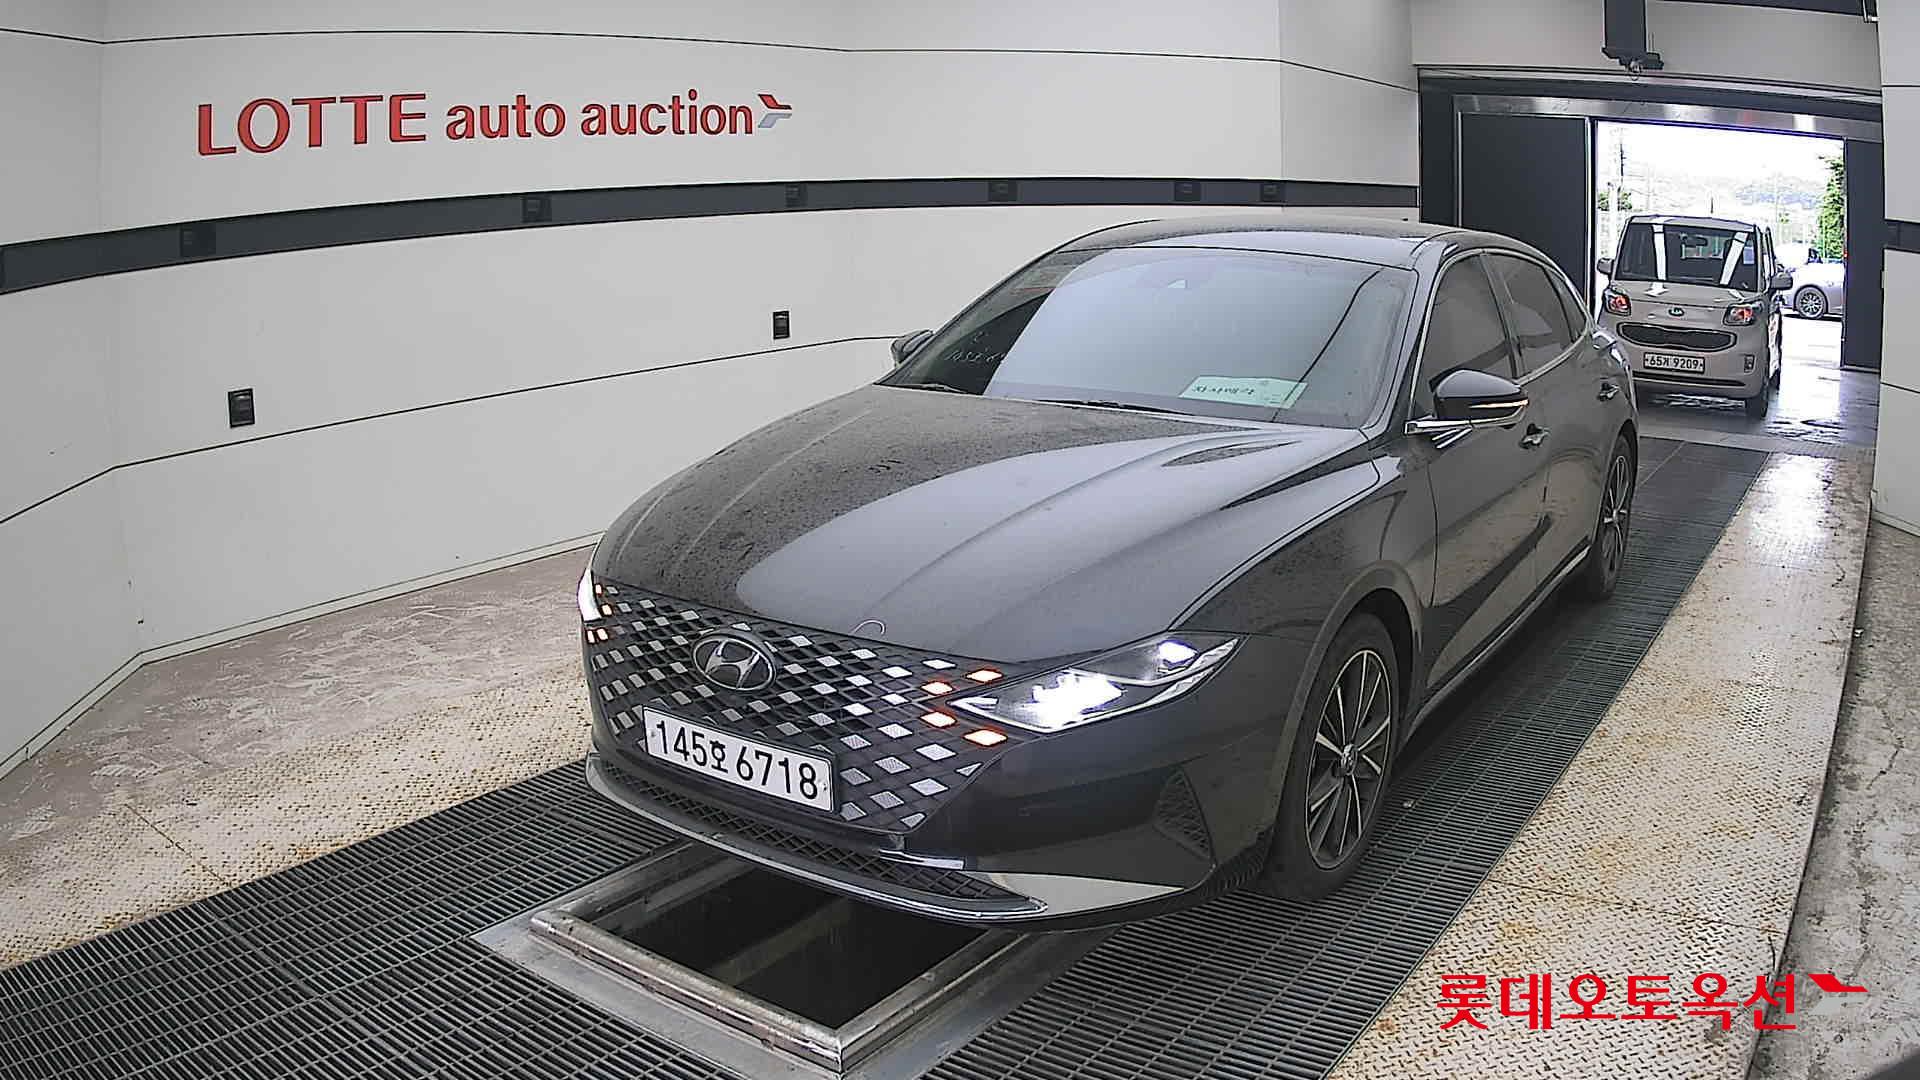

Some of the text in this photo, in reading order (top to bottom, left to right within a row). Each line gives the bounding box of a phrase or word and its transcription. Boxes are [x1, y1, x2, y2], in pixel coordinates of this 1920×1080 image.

[198, 88, 753, 155] LOTTE auto auction
[1673, 358, 1699, 369] 9209
[656, 720, 818, 800] 145호 6718
